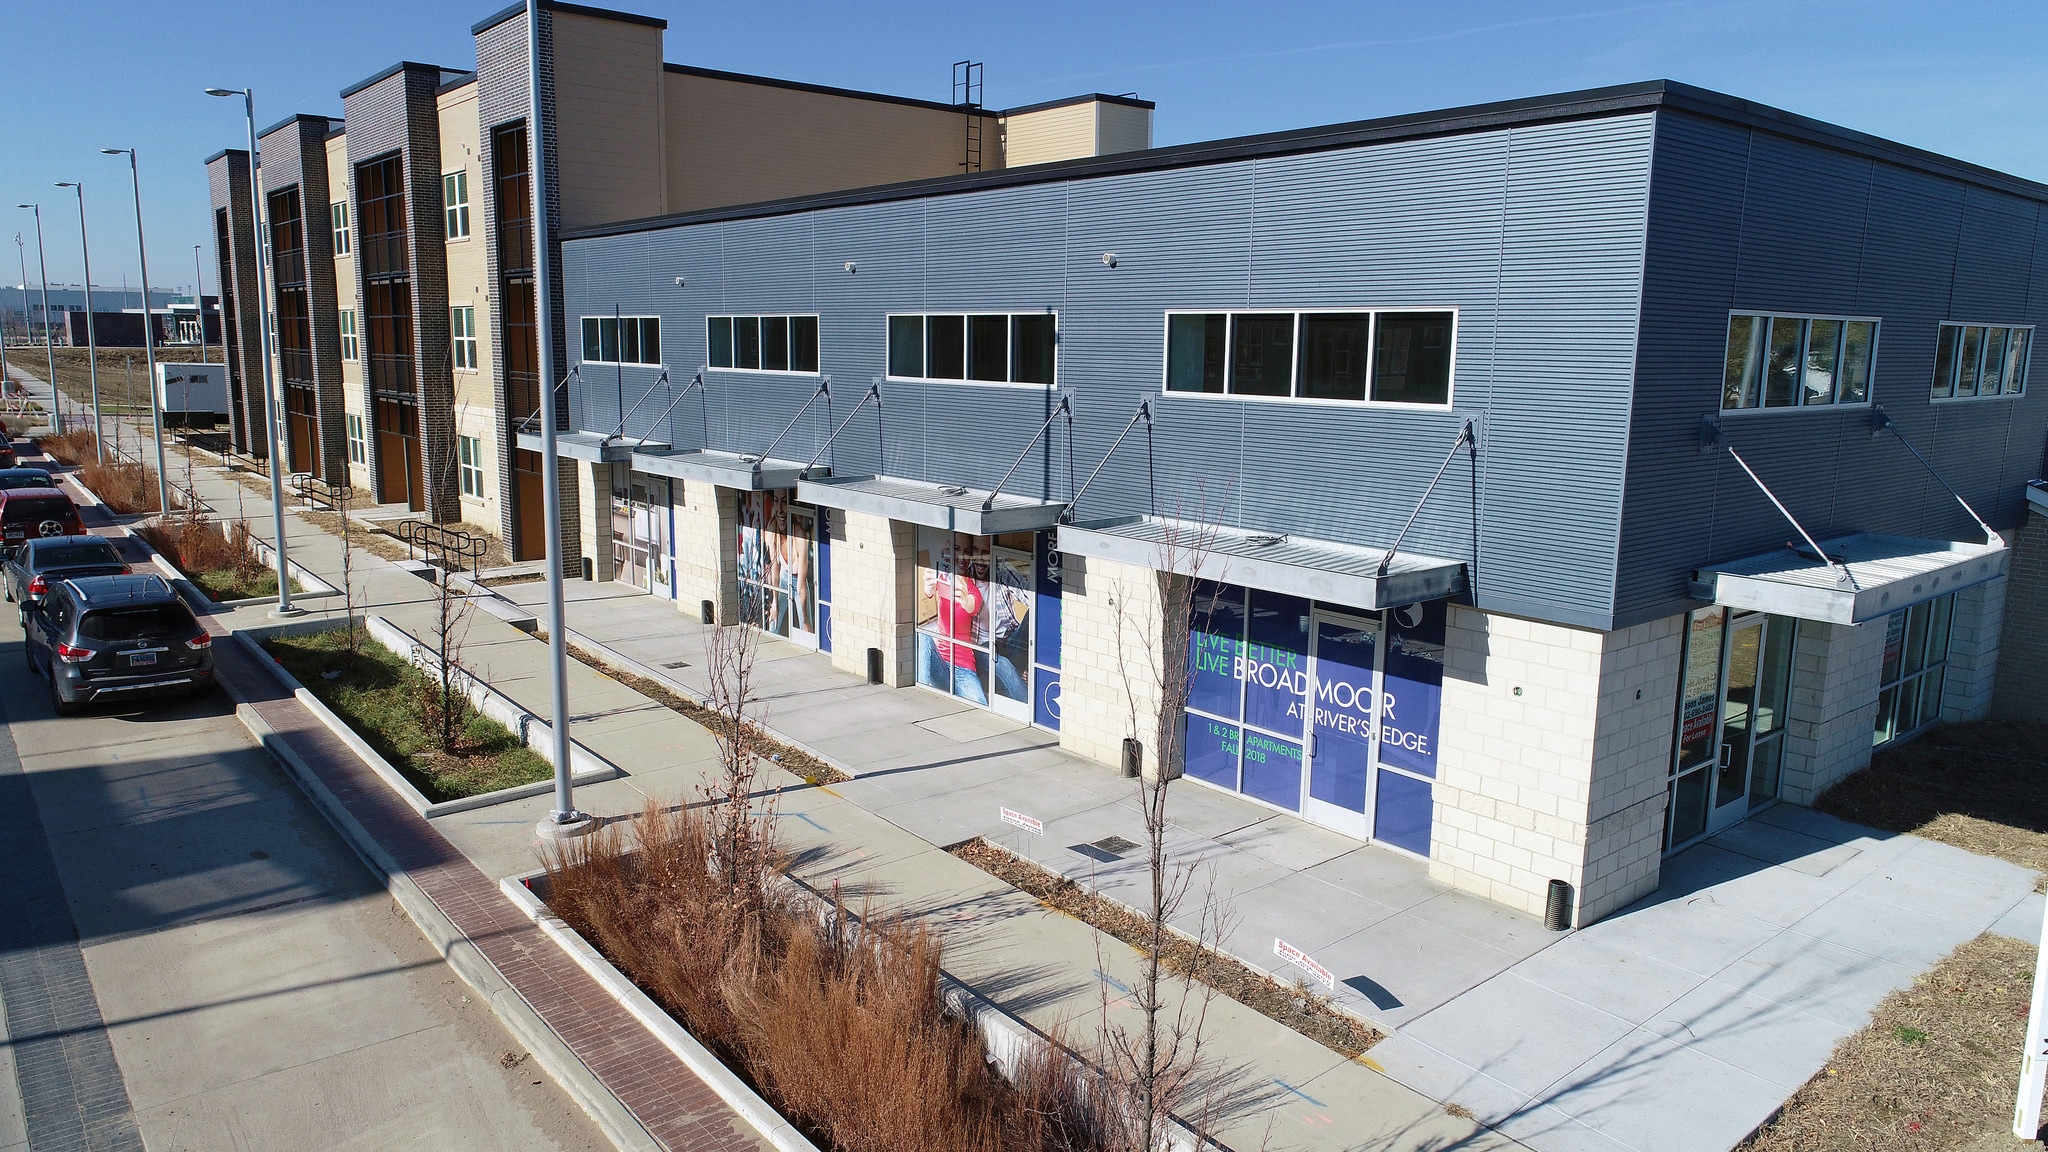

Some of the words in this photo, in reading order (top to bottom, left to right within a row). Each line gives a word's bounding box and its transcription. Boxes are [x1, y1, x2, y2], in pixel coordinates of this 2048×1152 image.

[1197, 624, 1229, 653] LIVE
[1235, 632, 1297, 670] BETTER
[1196, 647, 1229, 676] LIVE
[1233, 656, 1397, 720] BROADMOOR
[1208, 723, 1212, 733] 1
[1213, 724, 1220, 736] &
[1222, 727, 1228, 738] 2
[1246, 735, 1303, 761] APARTMENTS
[1286, 701, 1305, 720] AT
[1315, 707, 1370, 738] RIVER'S
[1382, 725, 1432, 756] EDGE.
[1221, 741, 1240, 756] FALL
[1245, 748, 1267, 764] 2018
[1278, 941, 1301, 959] Space
[1302, 954, 1332, 981] Available
